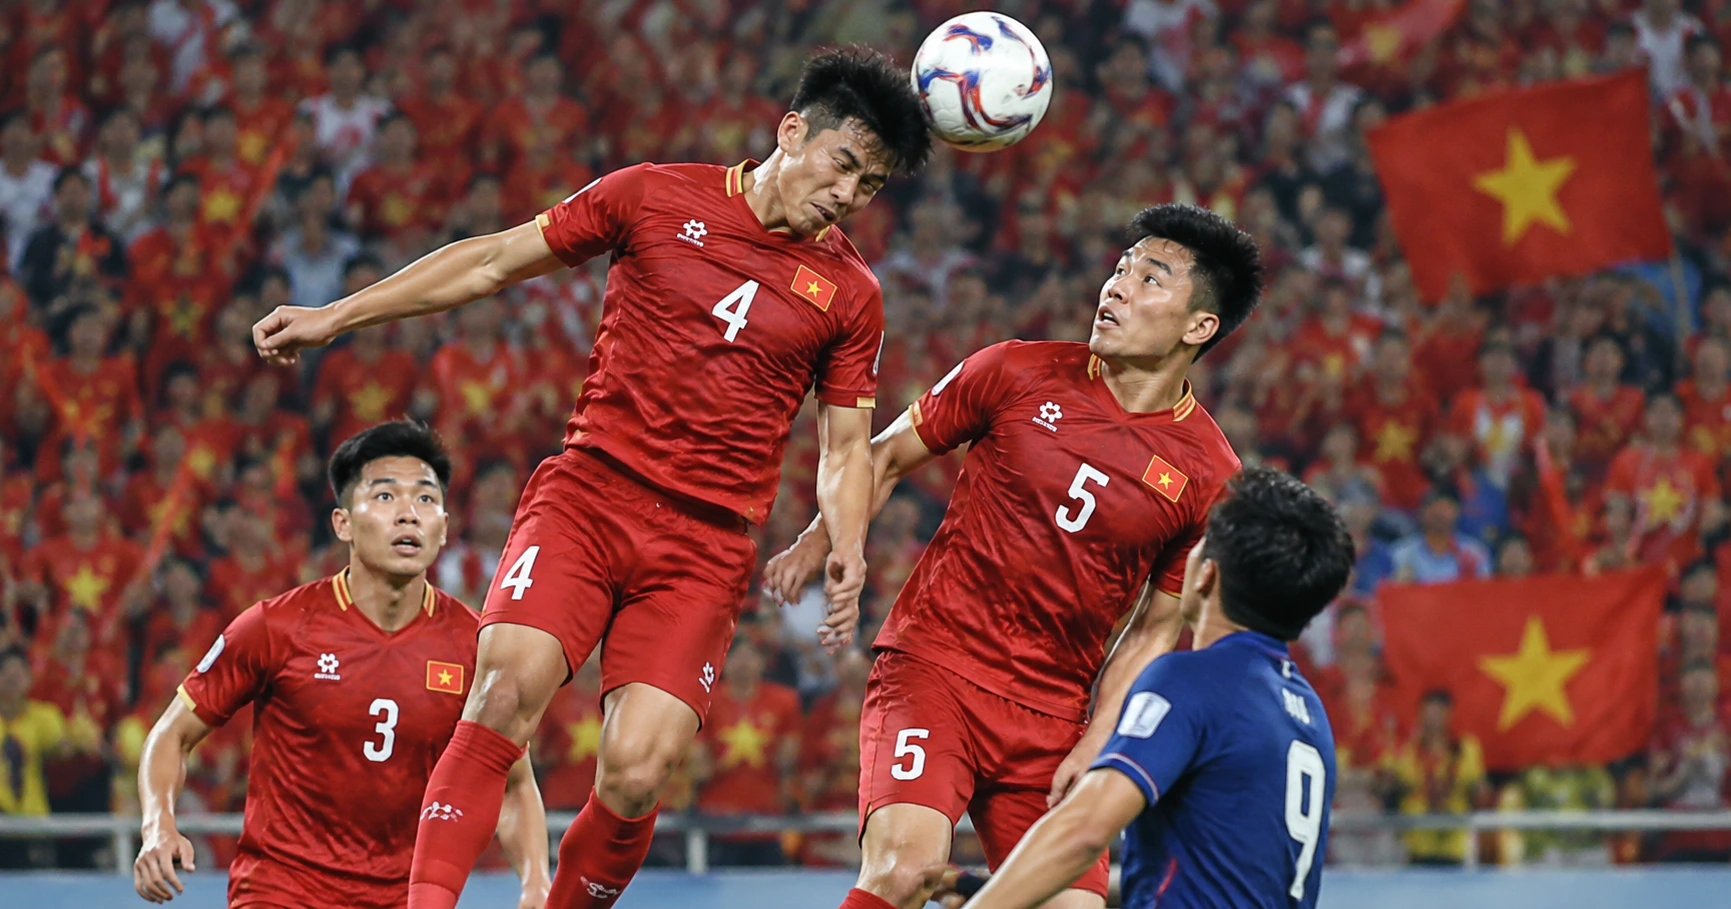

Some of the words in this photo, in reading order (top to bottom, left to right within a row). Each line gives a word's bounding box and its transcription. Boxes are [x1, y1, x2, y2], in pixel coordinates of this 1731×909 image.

[711, 279, 760, 343] 4
[1055, 462, 1110, 533] 5
[500, 545, 540, 600] 4
[363, 698, 399, 762] 3
[891, 728, 930, 780] 5
[1284, 739, 1326, 902] 9
